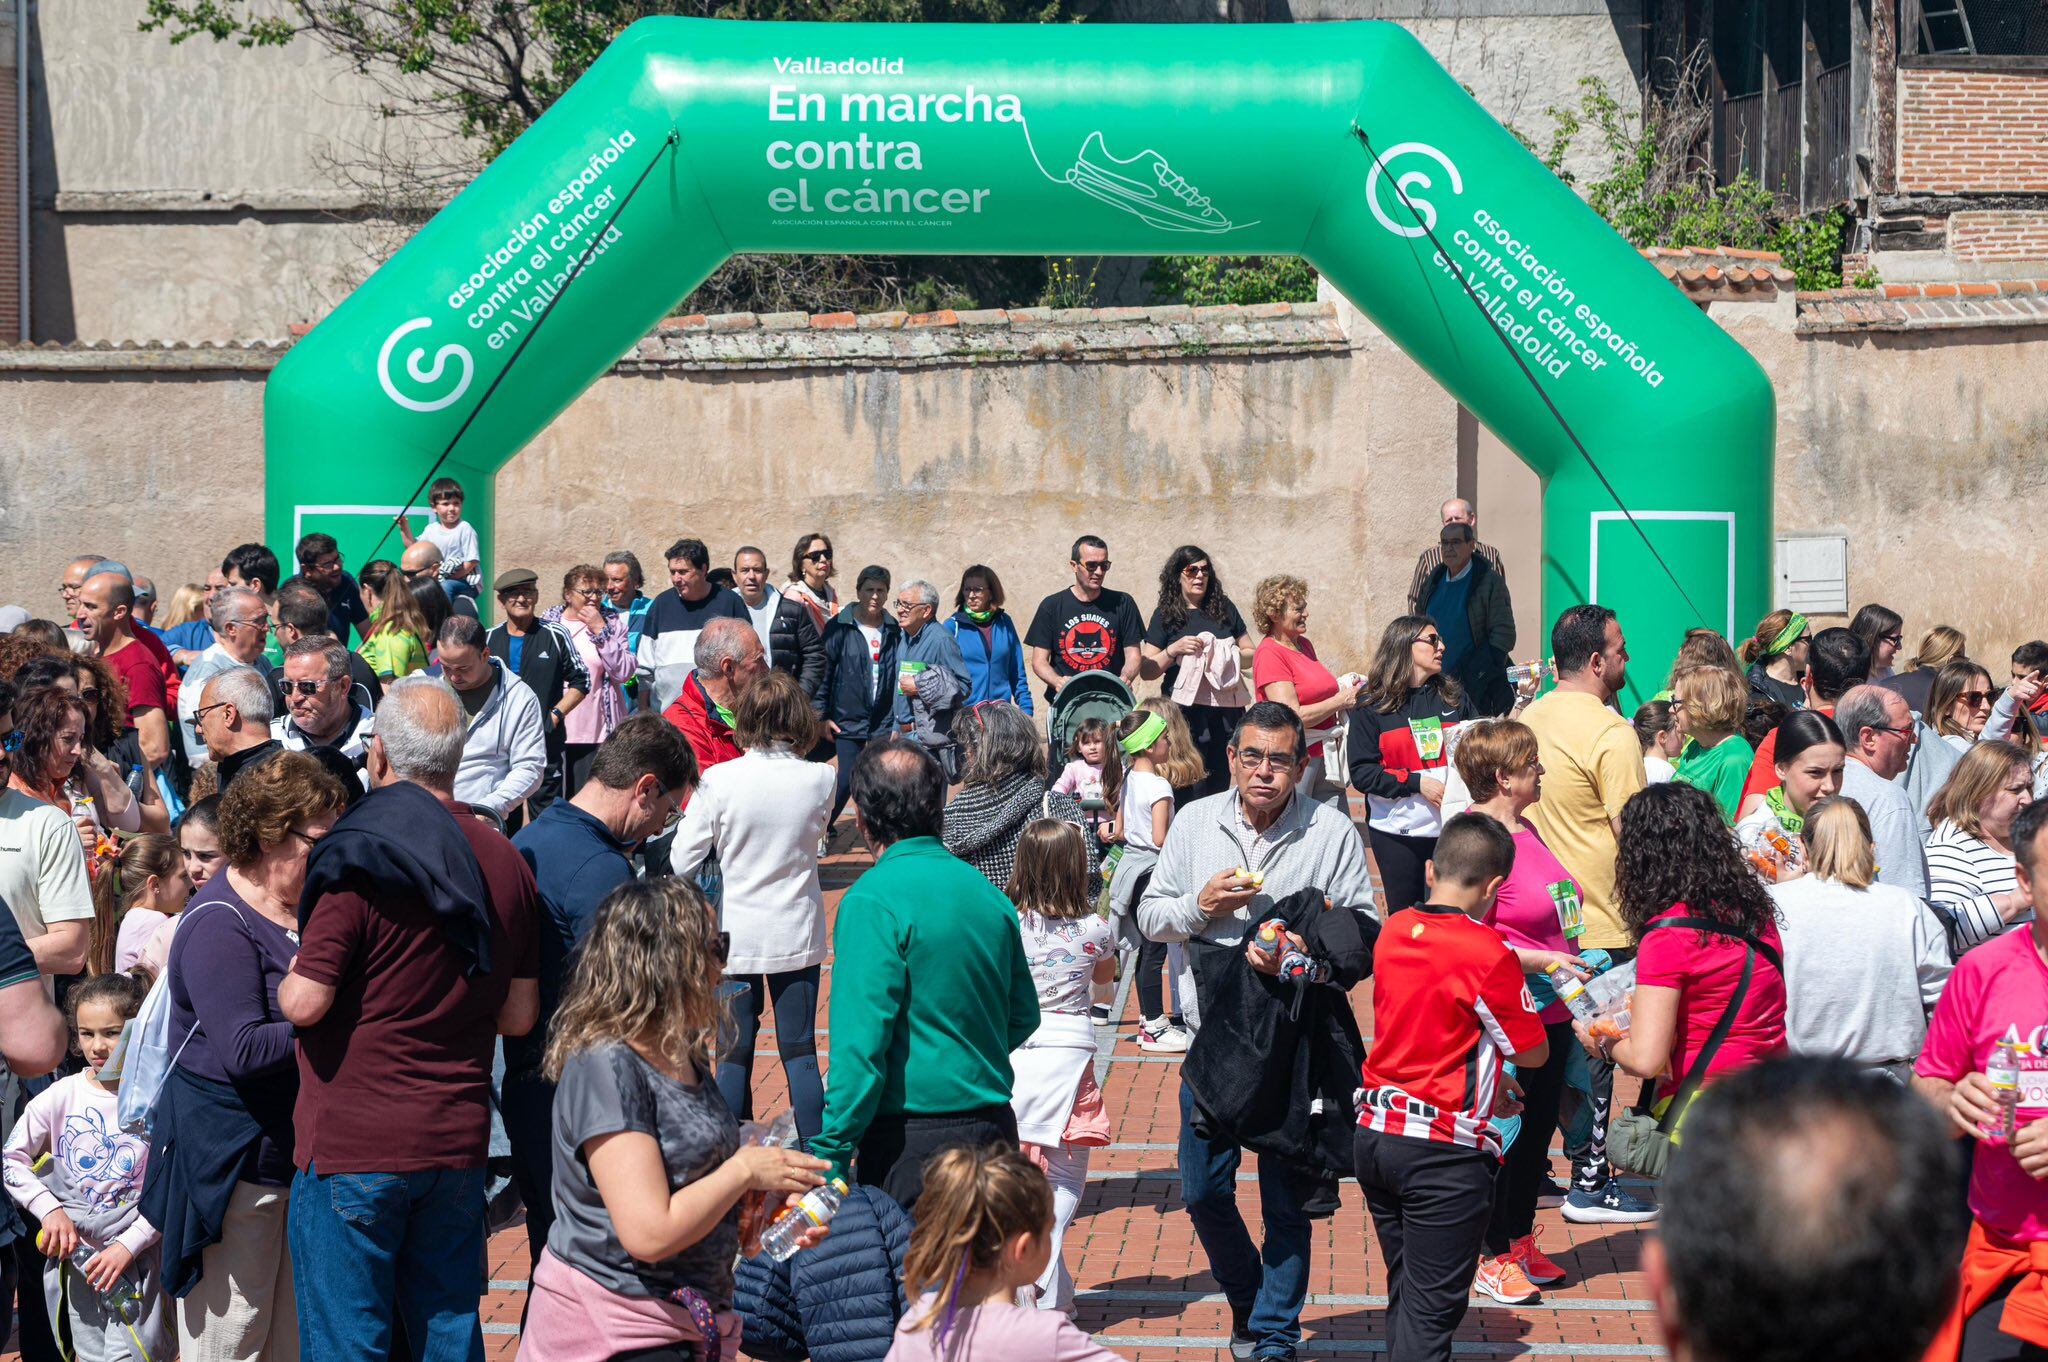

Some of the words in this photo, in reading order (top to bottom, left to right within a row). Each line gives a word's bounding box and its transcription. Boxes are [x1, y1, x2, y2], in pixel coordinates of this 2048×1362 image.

[773, 57, 904, 75] Valladolid
[768, 84, 826, 122] En
[841, 84, 1022, 122] marcha
[766, 132, 923, 170] contra
[768, 178, 814, 213] el
[824, 178, 990, 213] cáncer
[448, 212, 550, 309] asociación
[547, 128, 637, 215] española
[825, 218, 869, 226] ESPAÑOLA
[467, 266, 532, 329] contra
[530, 244, 552, 270] el
[549, 184, 617, 251] cáncer
[1432, 249, 1463, 280] en
[1463, 271, 1572, 379] Valladolid
[1453, 228, 1519, 292] contra
[1516, 289, 1543, 311] el
[1537, 304, 1608, 372] cáncer
[1473, 208, 1576, 306] asociación
[1574, 304, 1665, 388] española
[486, 320, 518, 350] en
[1065, 616, 1080, 630] LOS
[1081, 613, 1110, 628] SUAVES
